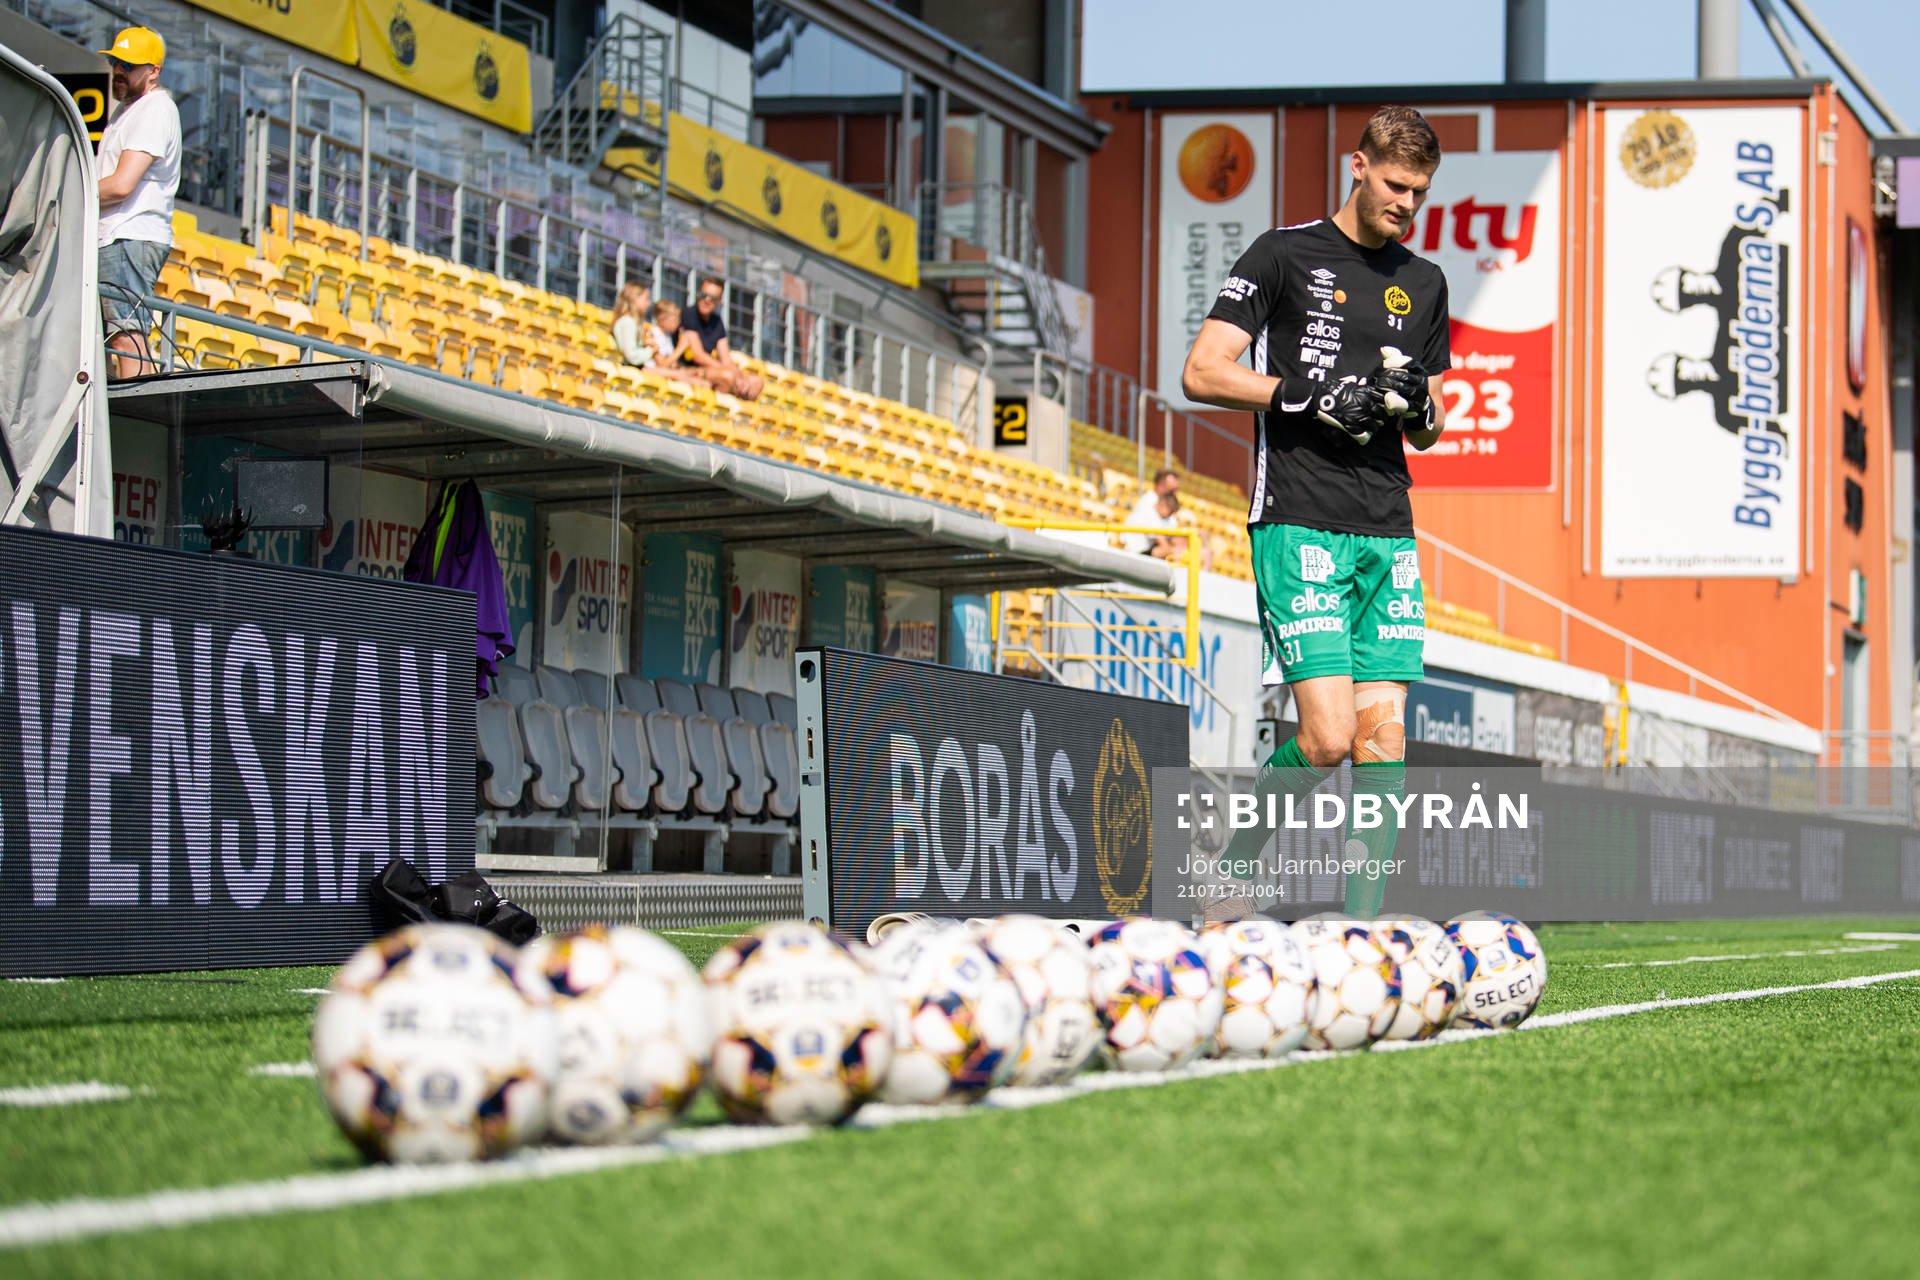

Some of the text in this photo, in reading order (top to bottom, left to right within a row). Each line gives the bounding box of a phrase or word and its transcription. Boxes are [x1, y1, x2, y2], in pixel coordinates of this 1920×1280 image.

[1306, 319, 1341, 340] ellos
[1387, 314, 1402, 331] 31
[1300, 336, 1342, 352] PULSEN
[1731, 241, 1781, 528] Bygg-bröderna
[685, 550, 717, 595] EFF
[683, 590, 721, 639] EKT
[755, 589, 799, 626] INTER
[1290, 586, 1341, 614] ellos
[1387, 593, 1425, 620] ellos
[681, 633, 704, 678] IV
[1283, 639, 1304, 666] 31
[0, 600, 447, 908] VENSKAN
[890, 708, 1079, 902] BORÅS
[1474, 973, 1535, 1009] SELECT
